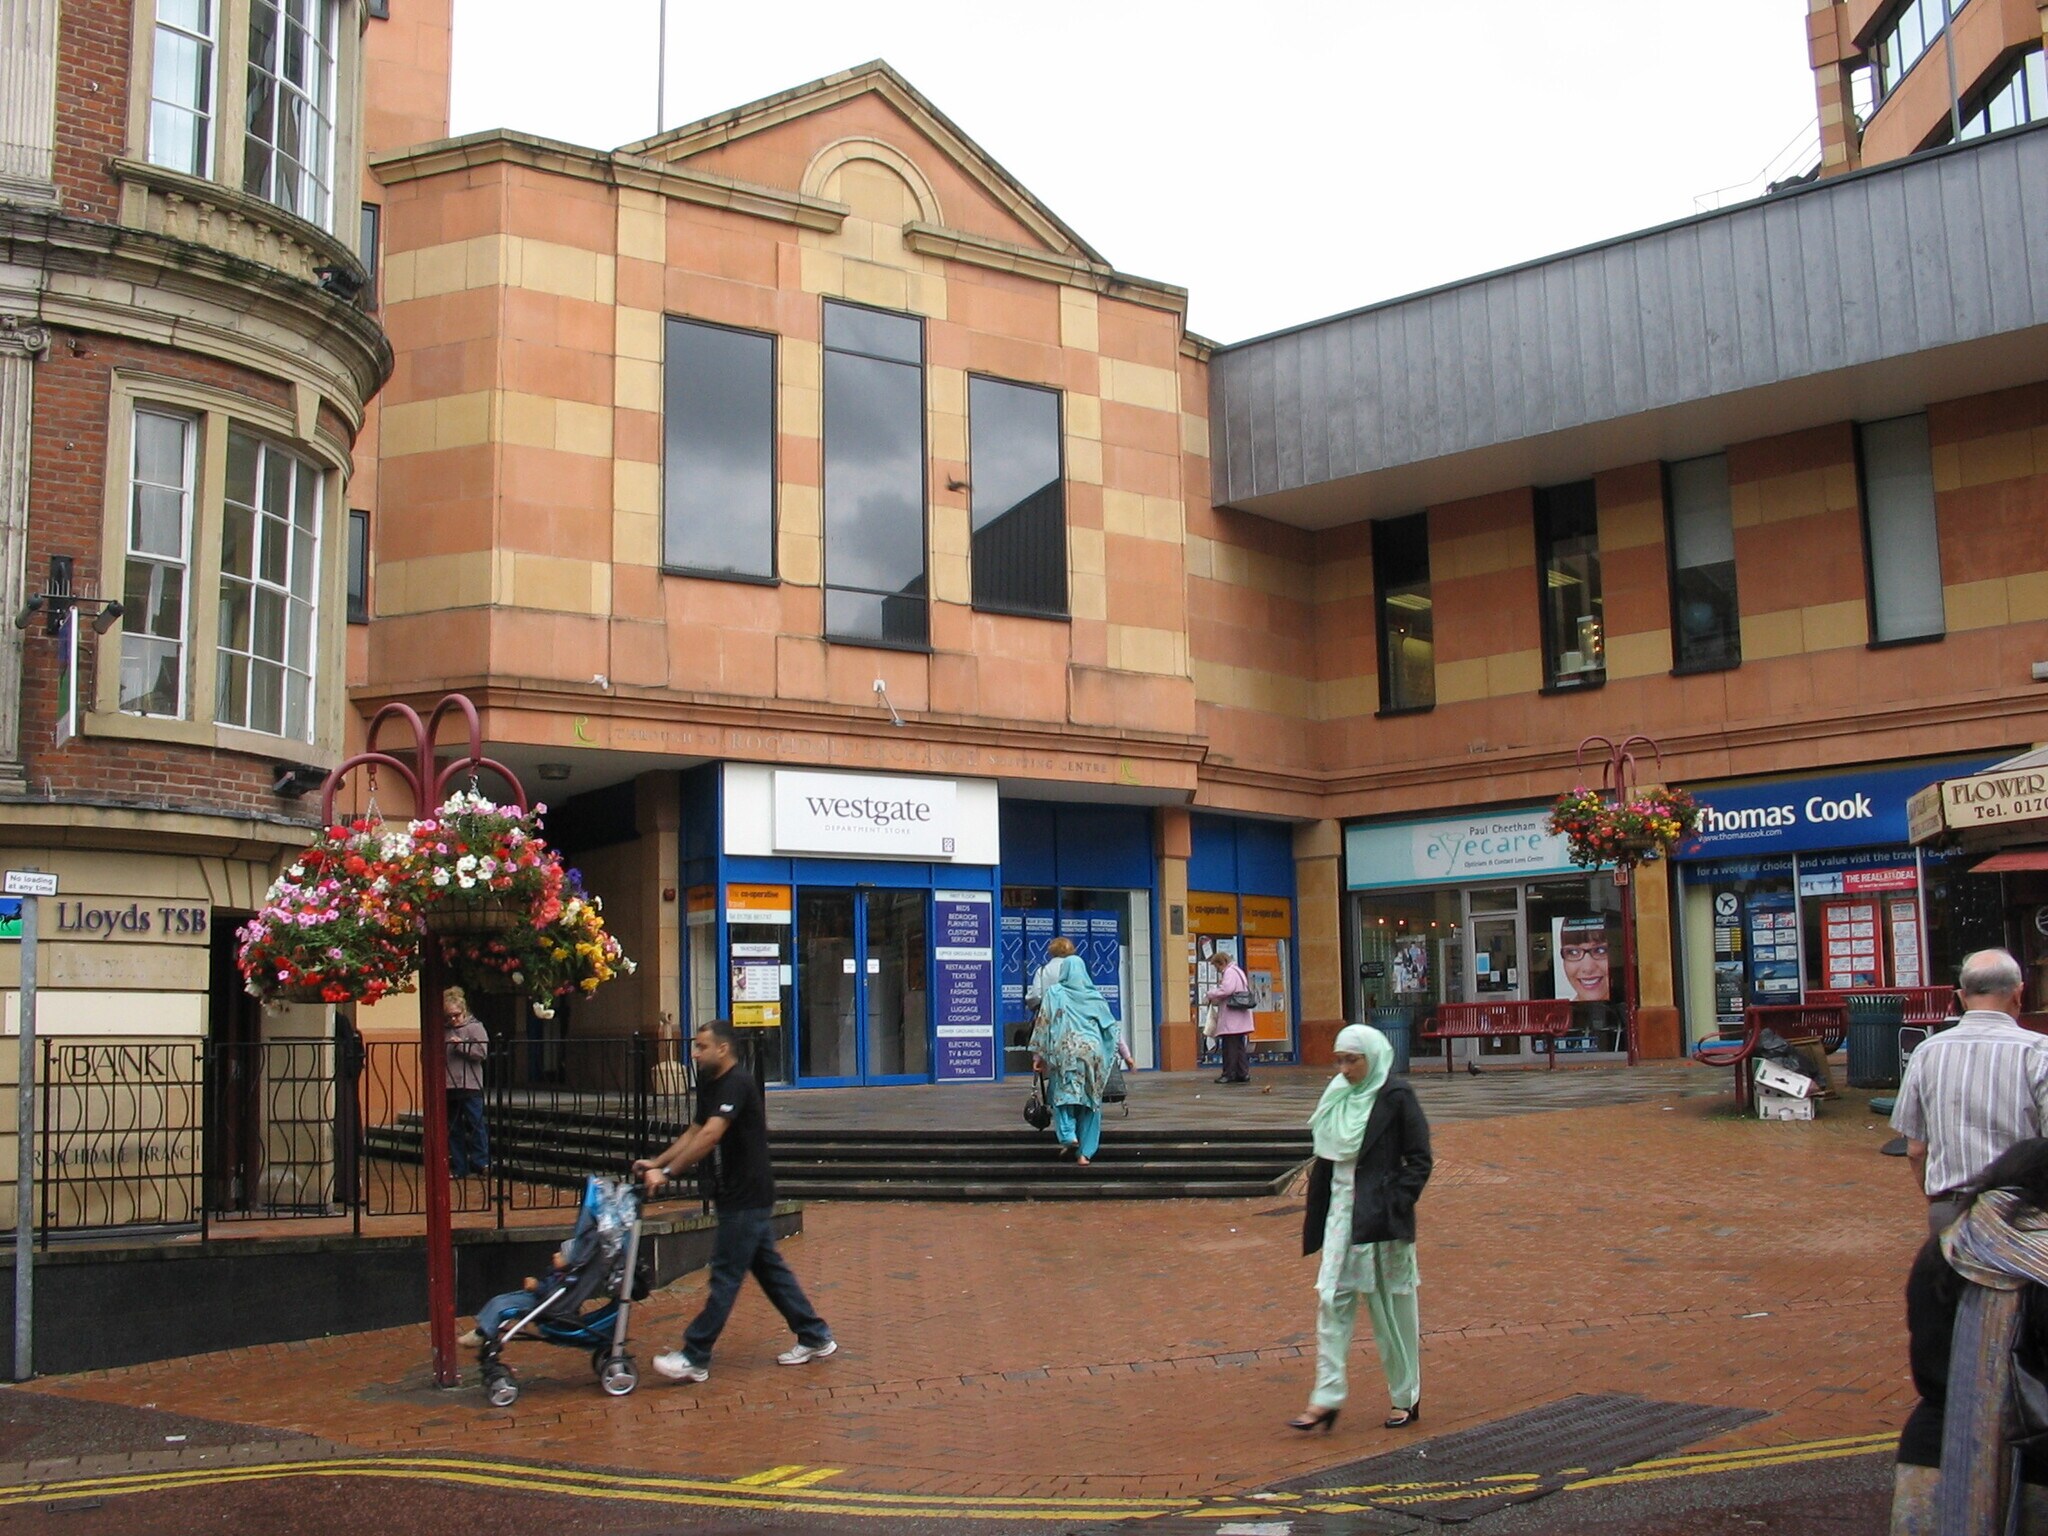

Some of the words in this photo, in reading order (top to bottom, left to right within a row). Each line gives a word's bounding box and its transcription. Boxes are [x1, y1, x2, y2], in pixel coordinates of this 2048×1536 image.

[1951, 774, 2047, 806] FLOWER
[805, 797, 931, 826] westgate
[1697, 805, 1796, 833] Thomas
[1805, 793, 1873, 823] Cook
[1974, 803, 2008, 819] Tel.
[825, 824, 881, 834] DEPARTMENT
[885, 827, 911, 835] STORE
[1469, 826, 1488, 836] Paul
[1492, 822, 1536, 834] Cheetham
[1427, 832, 1542, 875] eyecare
[1697, 866, 1711, 876] for
[1721, 864, 1748, 875] world
[1750, 863, 1760, 871] of
[1762, 860, 1793, 871] choice
[1800, 858, 1818, 868] and
[1820, 856, 1848, 866] value
[1849, 853, 1870, 864] visit
[1873, 851, 1890, 862] the
[24, 876, 53, 885] loading
[1846, 874, 1860, 884] THE
[1896, 870, 1917, 880] DEAL
[58, 902, 150, 939] Lloyds
[158, 907, 207, 934] TSB
[945, 963, 982, 971] RESTAURANT
[70, 1046, 166, 1078] BANK
[949, 1058, 981, 1066] FURNITURE
